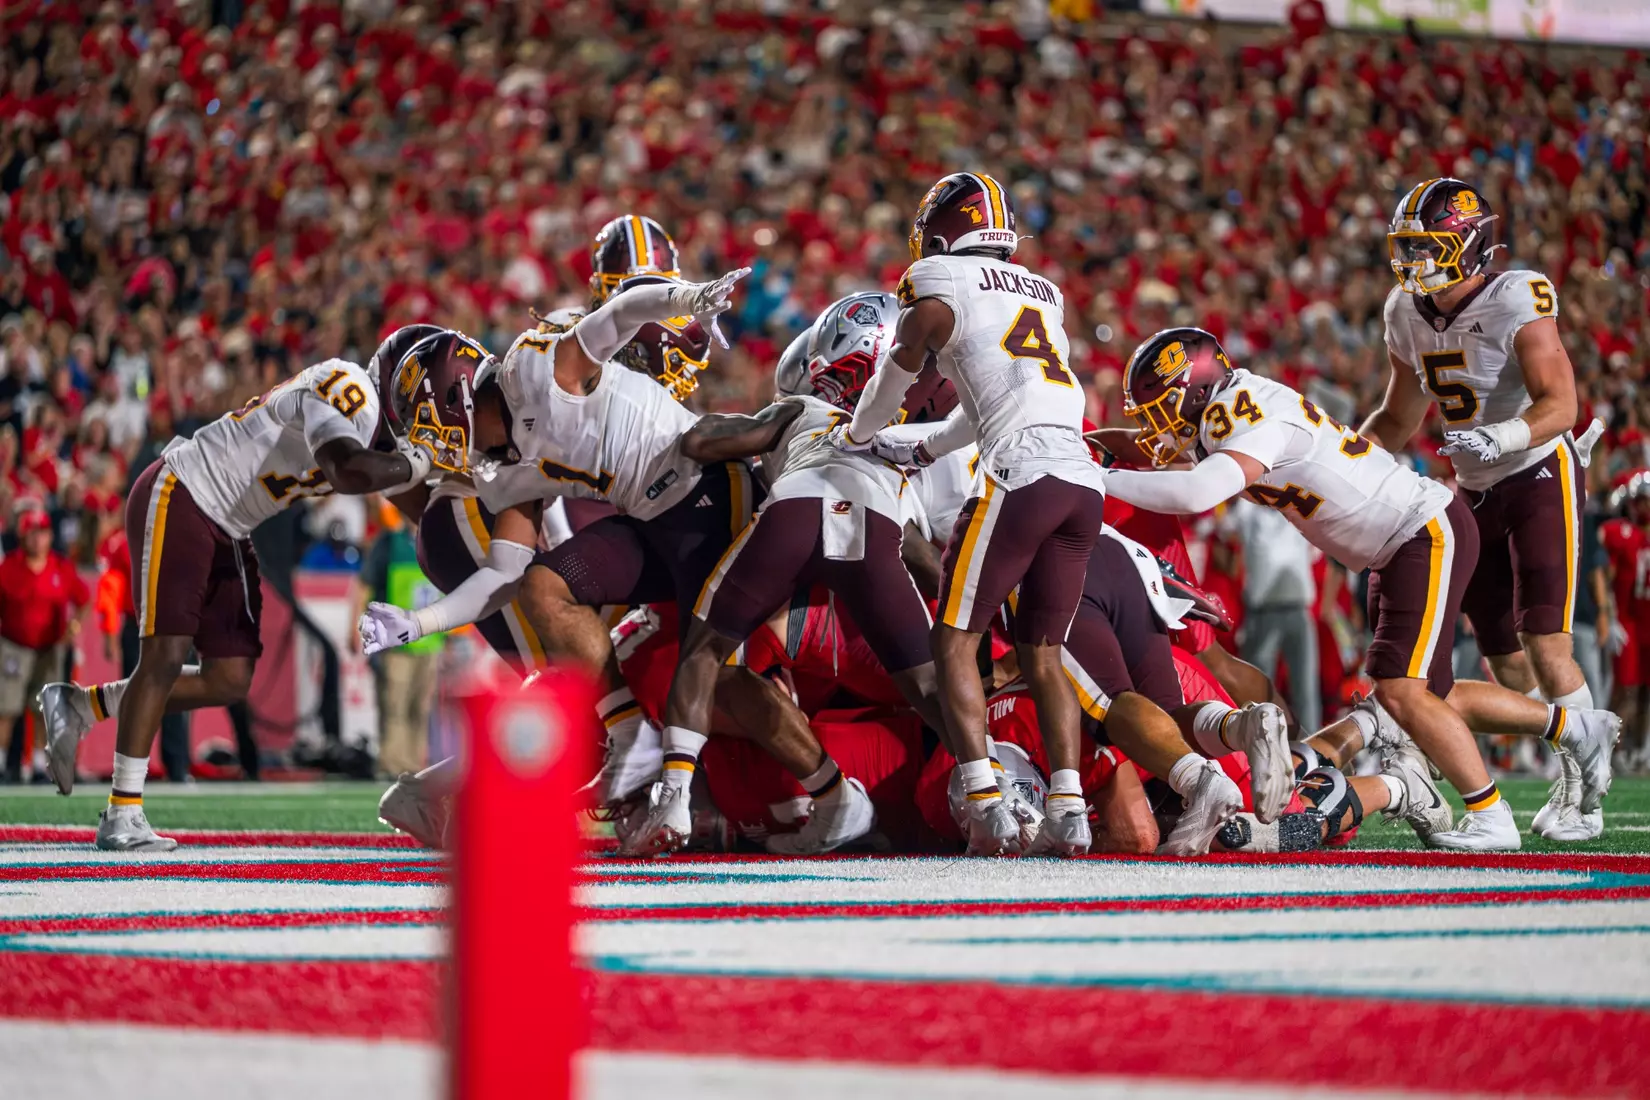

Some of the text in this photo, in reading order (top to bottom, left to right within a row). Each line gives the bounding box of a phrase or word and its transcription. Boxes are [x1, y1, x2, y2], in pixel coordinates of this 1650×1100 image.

[979, 232, 1014, 244] TRUTH
[979, 267, 1058, 307] JACKSON
[1528, 279, 1554, 316] 5
[517, 336, 553, 355] 1
[1000, 304, 1075, 388] 4
[315, 369, 367, 420] 19
[1421, 350, 1481, 425] 5
[1203, 388, 1265, 441] 34
[537, 457, 616, 496] 1
